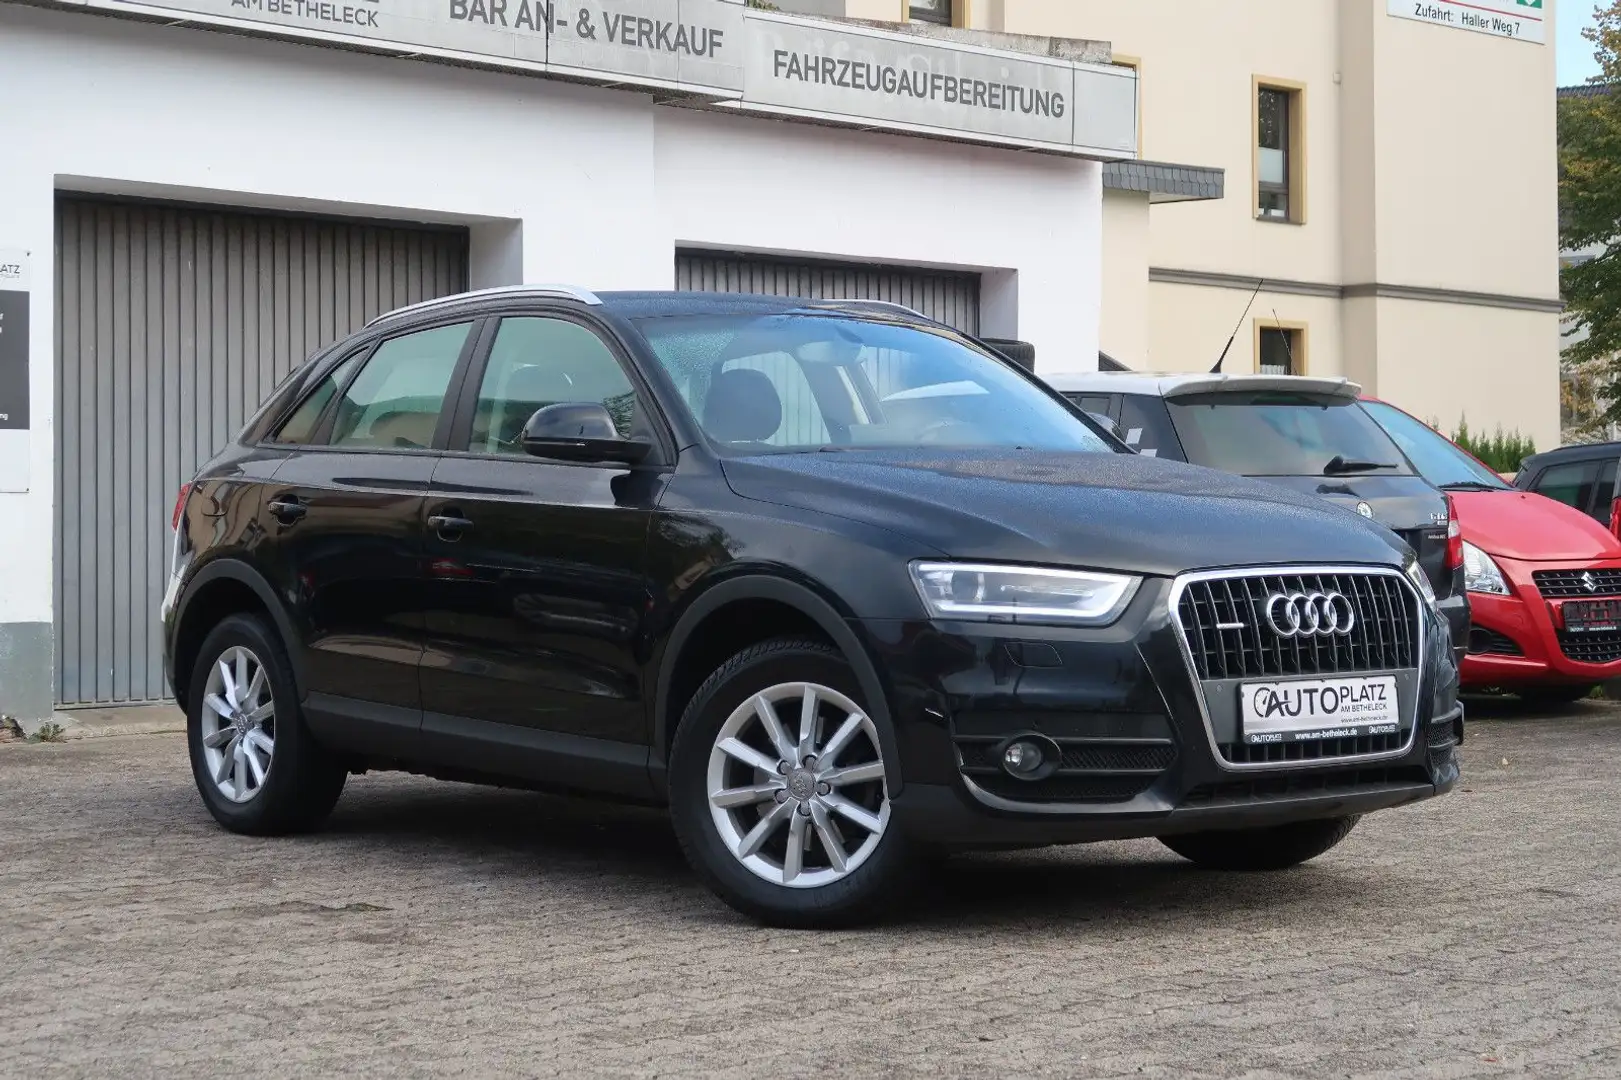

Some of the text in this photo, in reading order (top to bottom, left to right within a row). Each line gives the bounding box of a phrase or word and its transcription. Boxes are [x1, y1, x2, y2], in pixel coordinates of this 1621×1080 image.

[268, 0, 379, 27] BETHELECK
[1415, 3, 1521, 36] Zufahrt: Haller Weg 7
[450, 0, 508, 27] BAR
[576, 8, 597, 40] &
[602, 11, 724, 58] VERKAUF
[773, 49, 1065, 119] FAHRZEUGAUFBEREITUNG
[0, 263, 21, 274] ATZ
[1341, 703, 1388, 713] AM BETHELECK
